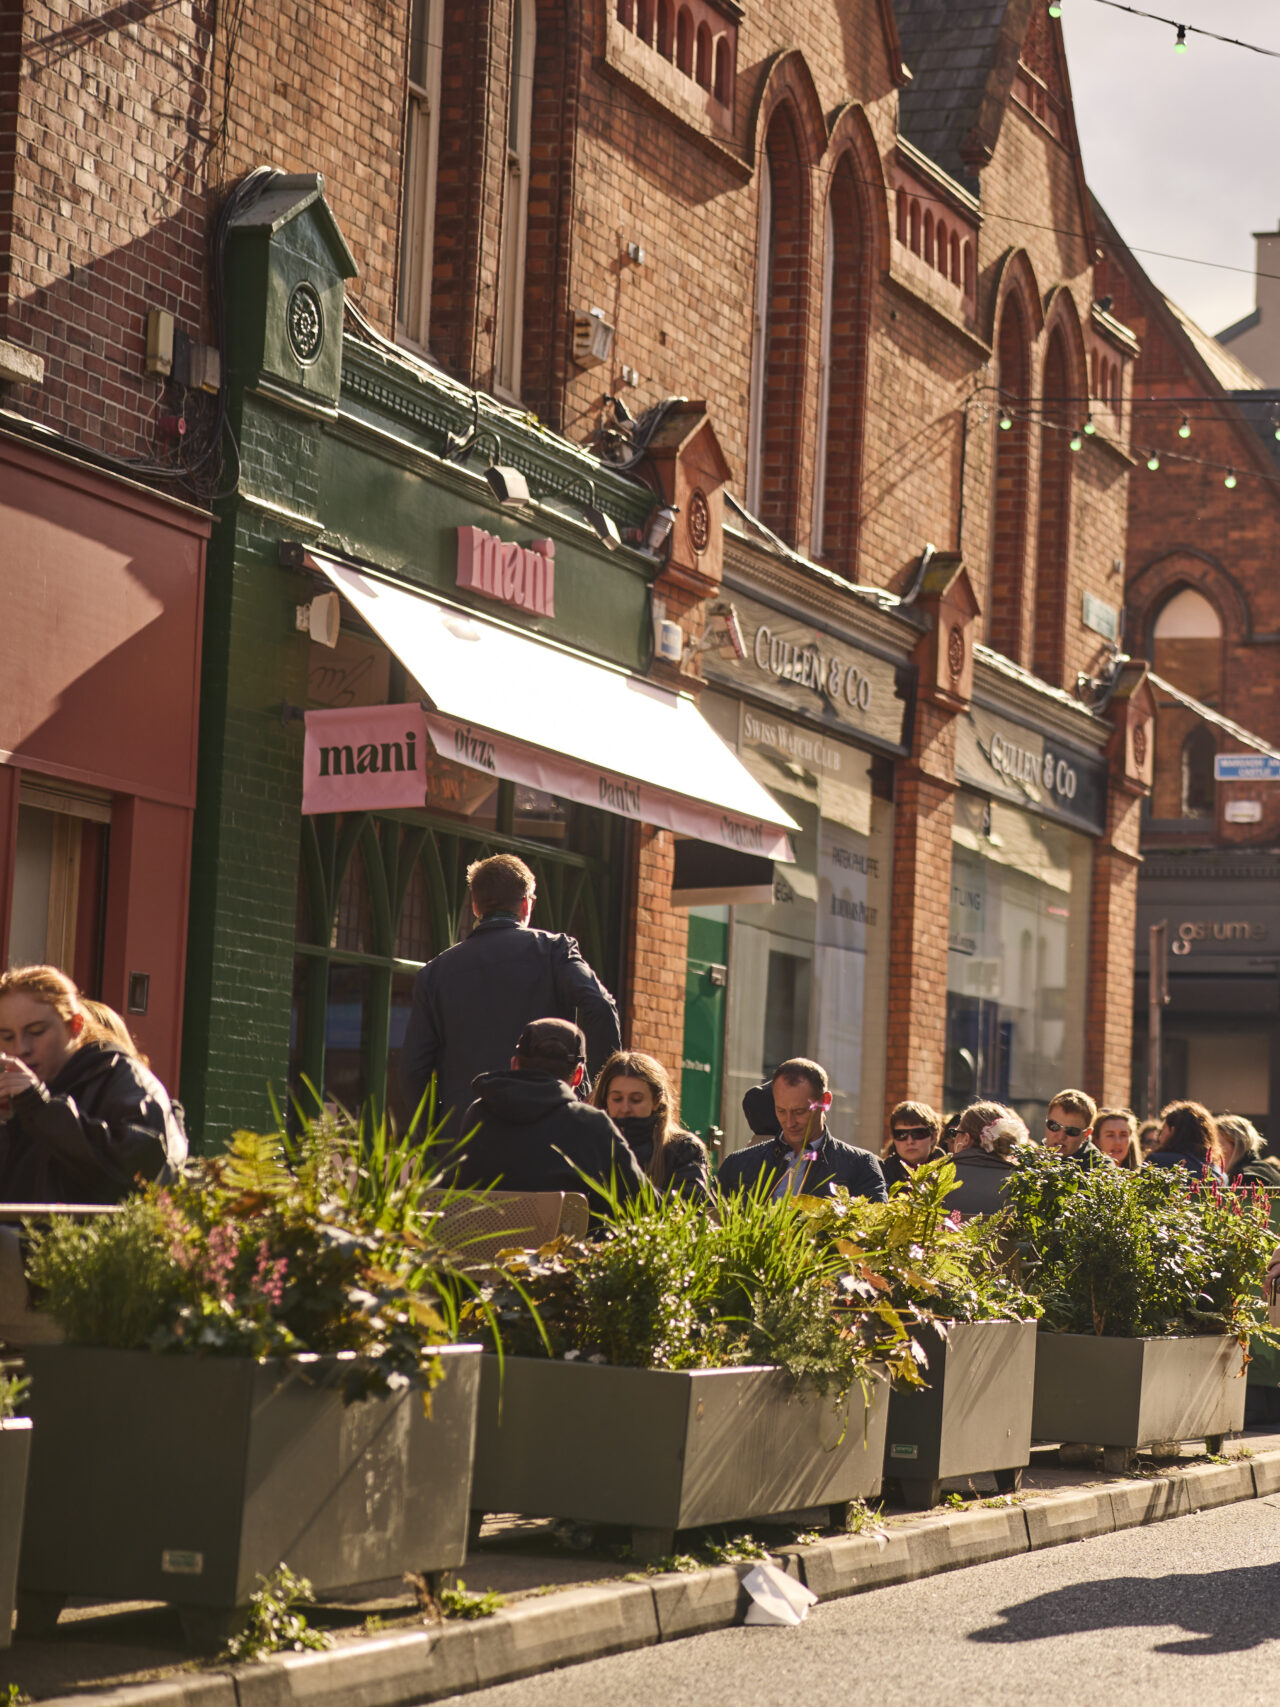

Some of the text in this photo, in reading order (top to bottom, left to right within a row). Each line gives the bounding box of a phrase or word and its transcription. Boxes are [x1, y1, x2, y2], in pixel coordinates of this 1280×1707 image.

[460, 525, 555, 618] mani
[755, 625, 825, 692] CULLEN
[828, 656, 840, 698] &
[846, 665, 871, 711] CO
[318, 731, 417, 777] mani
[454, 727, 496, 772] Pizza
[991, 732, 1077, 799] CULLEN & CO
[775, 881, 793, 904] EGA
